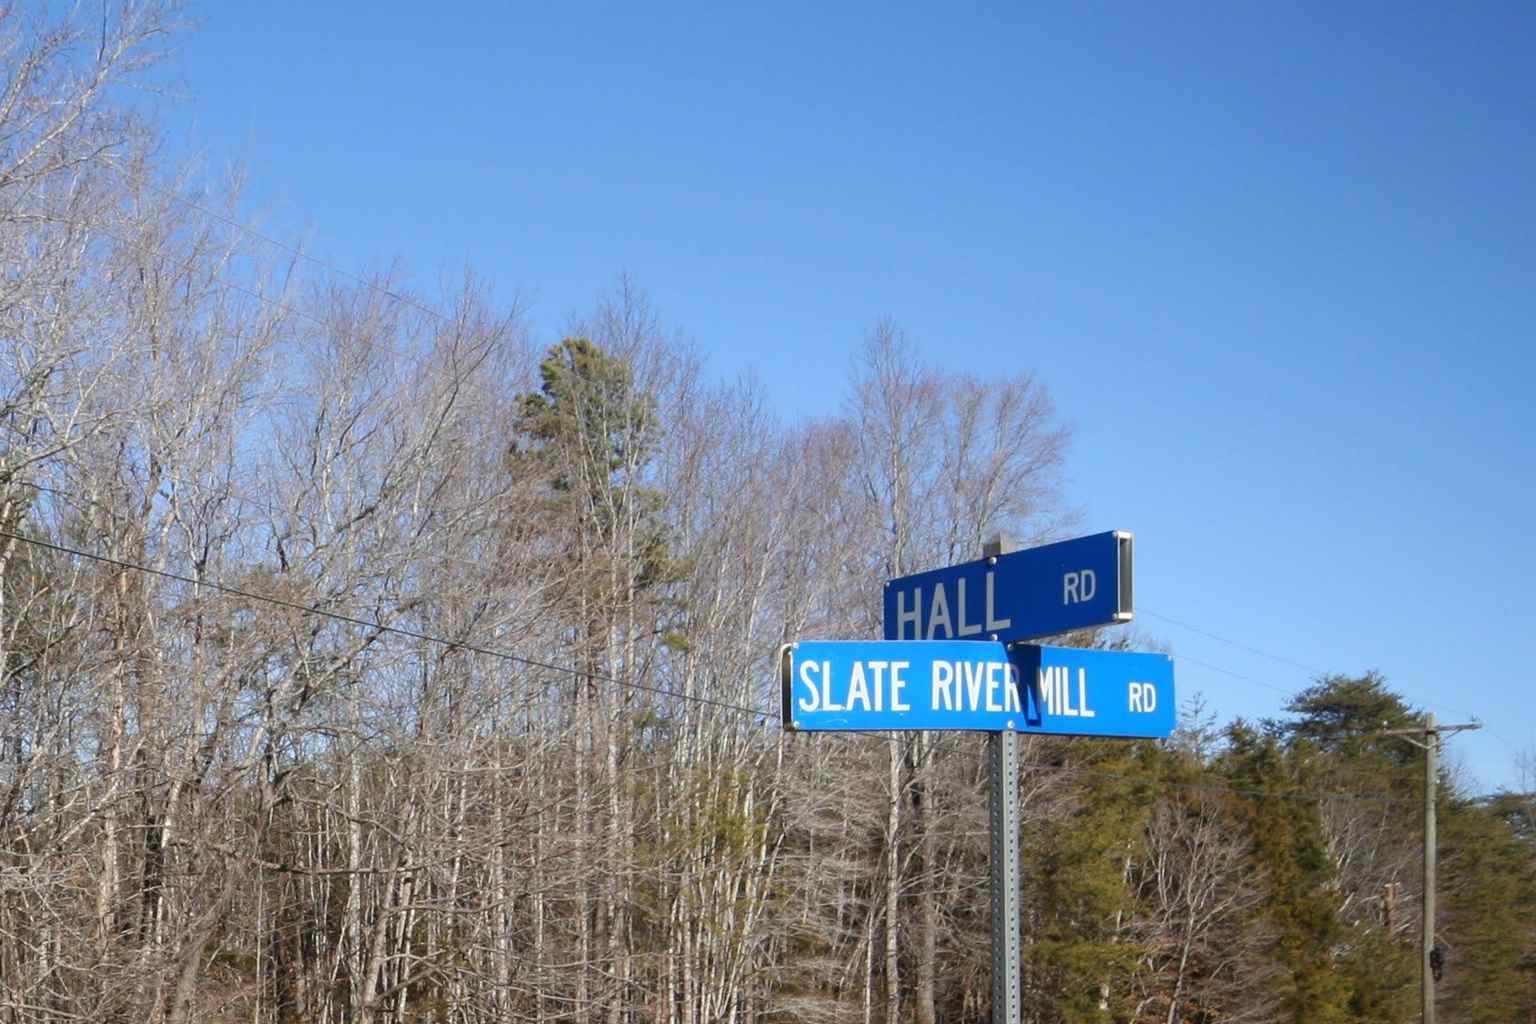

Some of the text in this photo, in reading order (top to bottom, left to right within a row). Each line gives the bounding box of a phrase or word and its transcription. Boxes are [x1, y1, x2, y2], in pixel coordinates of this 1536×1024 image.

[896, 569, 1096, 640] HALL RD
[799, 660, 1157, 718] SLATE RIVER MILL RD
